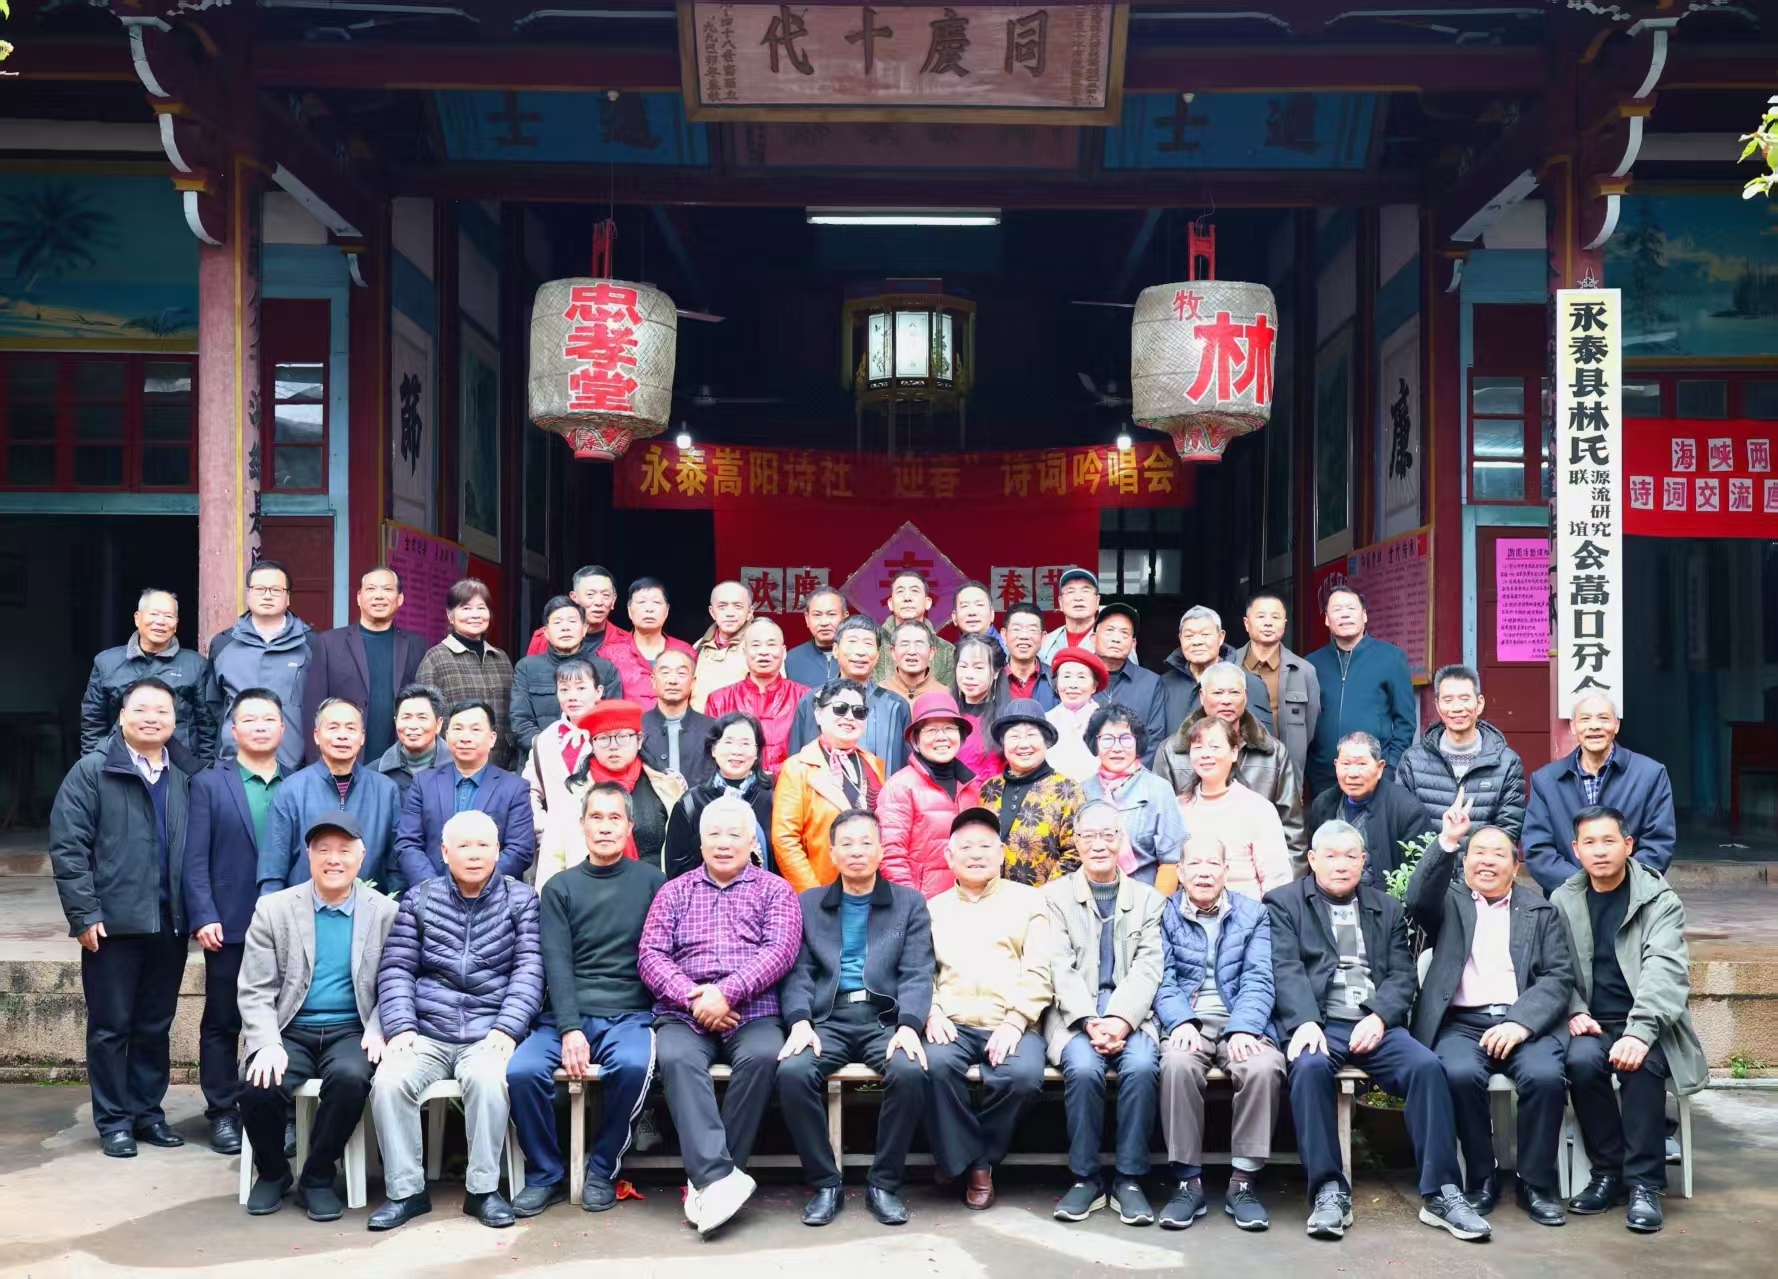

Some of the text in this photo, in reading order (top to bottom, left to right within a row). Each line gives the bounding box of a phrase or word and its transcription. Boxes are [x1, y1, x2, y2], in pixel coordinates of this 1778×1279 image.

[1173, 289, 1205, 321] 牧
[562, 283, 643, 414] 忠孝堂
[1184, 311, 1276, 406] 林
[639, 444, 854, 497] 永泰嵩阳诗社
[1001, 445, 1175, 497] 诗词吟唱会
[1674, 440, 1769, 470] 海峡两
